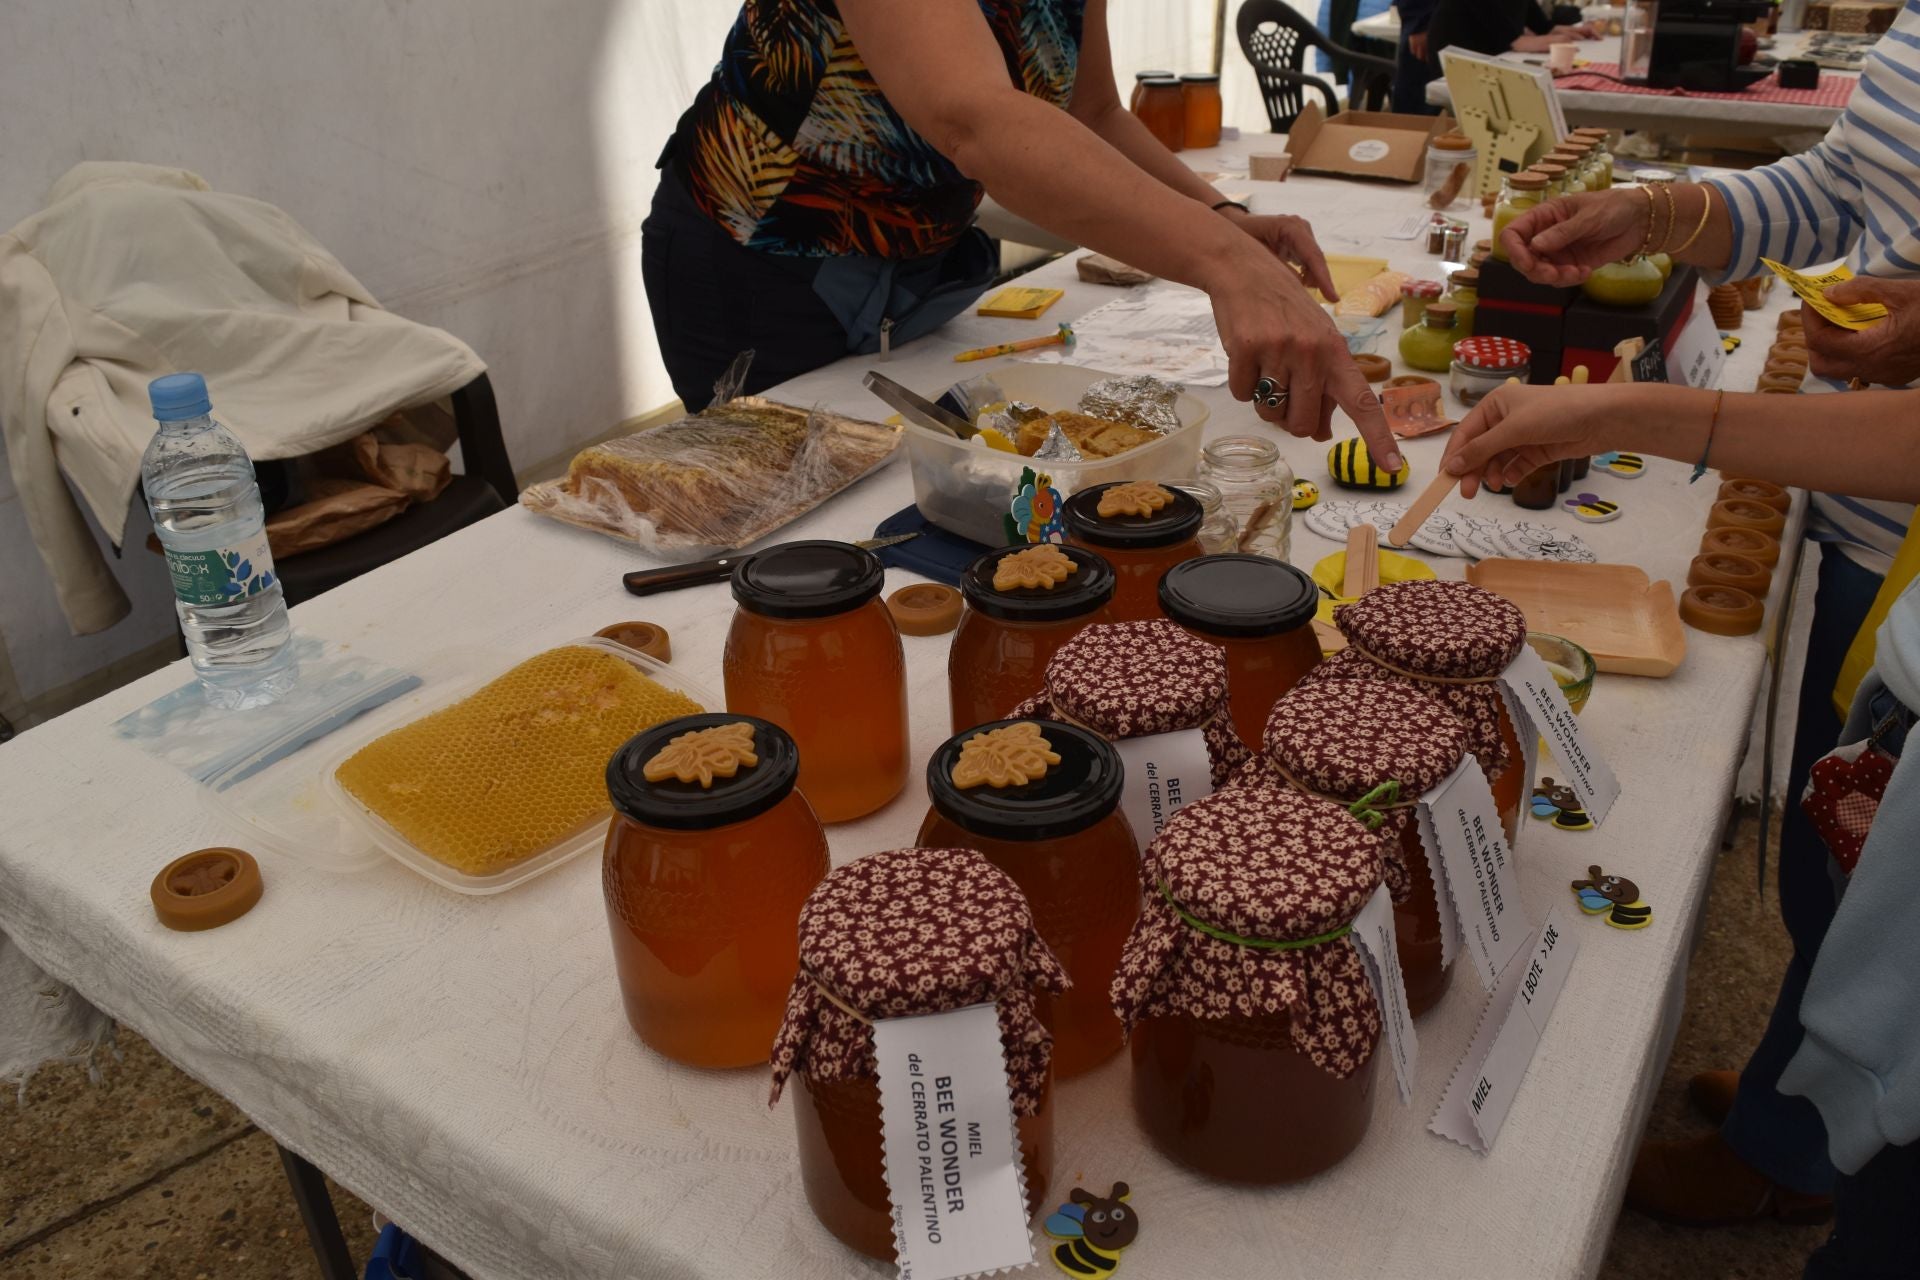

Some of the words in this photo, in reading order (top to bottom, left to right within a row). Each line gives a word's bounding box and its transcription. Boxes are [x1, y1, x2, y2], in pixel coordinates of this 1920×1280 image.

[1525, 681, 1536, 697] del
[1535, 698, 1562, 742] CERRATO
[1562, 742, 1595, 796] PALENTINO
[1540, 687, 1556, 713] BEE
[1556, 712, 1591, 773] WONDER
[1563, 710, 1579, 734] MIEL
[1146, 762, 1158, 780] del
[1166, 778, 1182, 806] BEE
[1472, 815, 1487, 846] BEE
[1481, 845, 1504, 916] WONDER
[1492, 842, 1506, 870] MIEL
[1457, 808, 1466, 827] del
[1464, 826, 1483, 880] CERRATO
[1478, 880, 1500, 943] PALENTINO
[1544, 924, 1560, 952] 10€
[1524, 959, 1544, 996] BOTE
[1520, 990, 1532, 1006] 1
[908, 1053, 924, 1077] del
[935, 1076, 954, 1114] BEE
[1471, 1075, 1492, 1116] MIEL
[911, 1082, 931, 1154] CERRATO
[968, 1122, 983, 1159] MIEL
[940, 1118, 964, 1214] WONDER
[894, 1204, 904, 1228] Peso
[919, 1155, 942, 1244] PALENTINO
[898, 1230, 908, 1255] neto:
